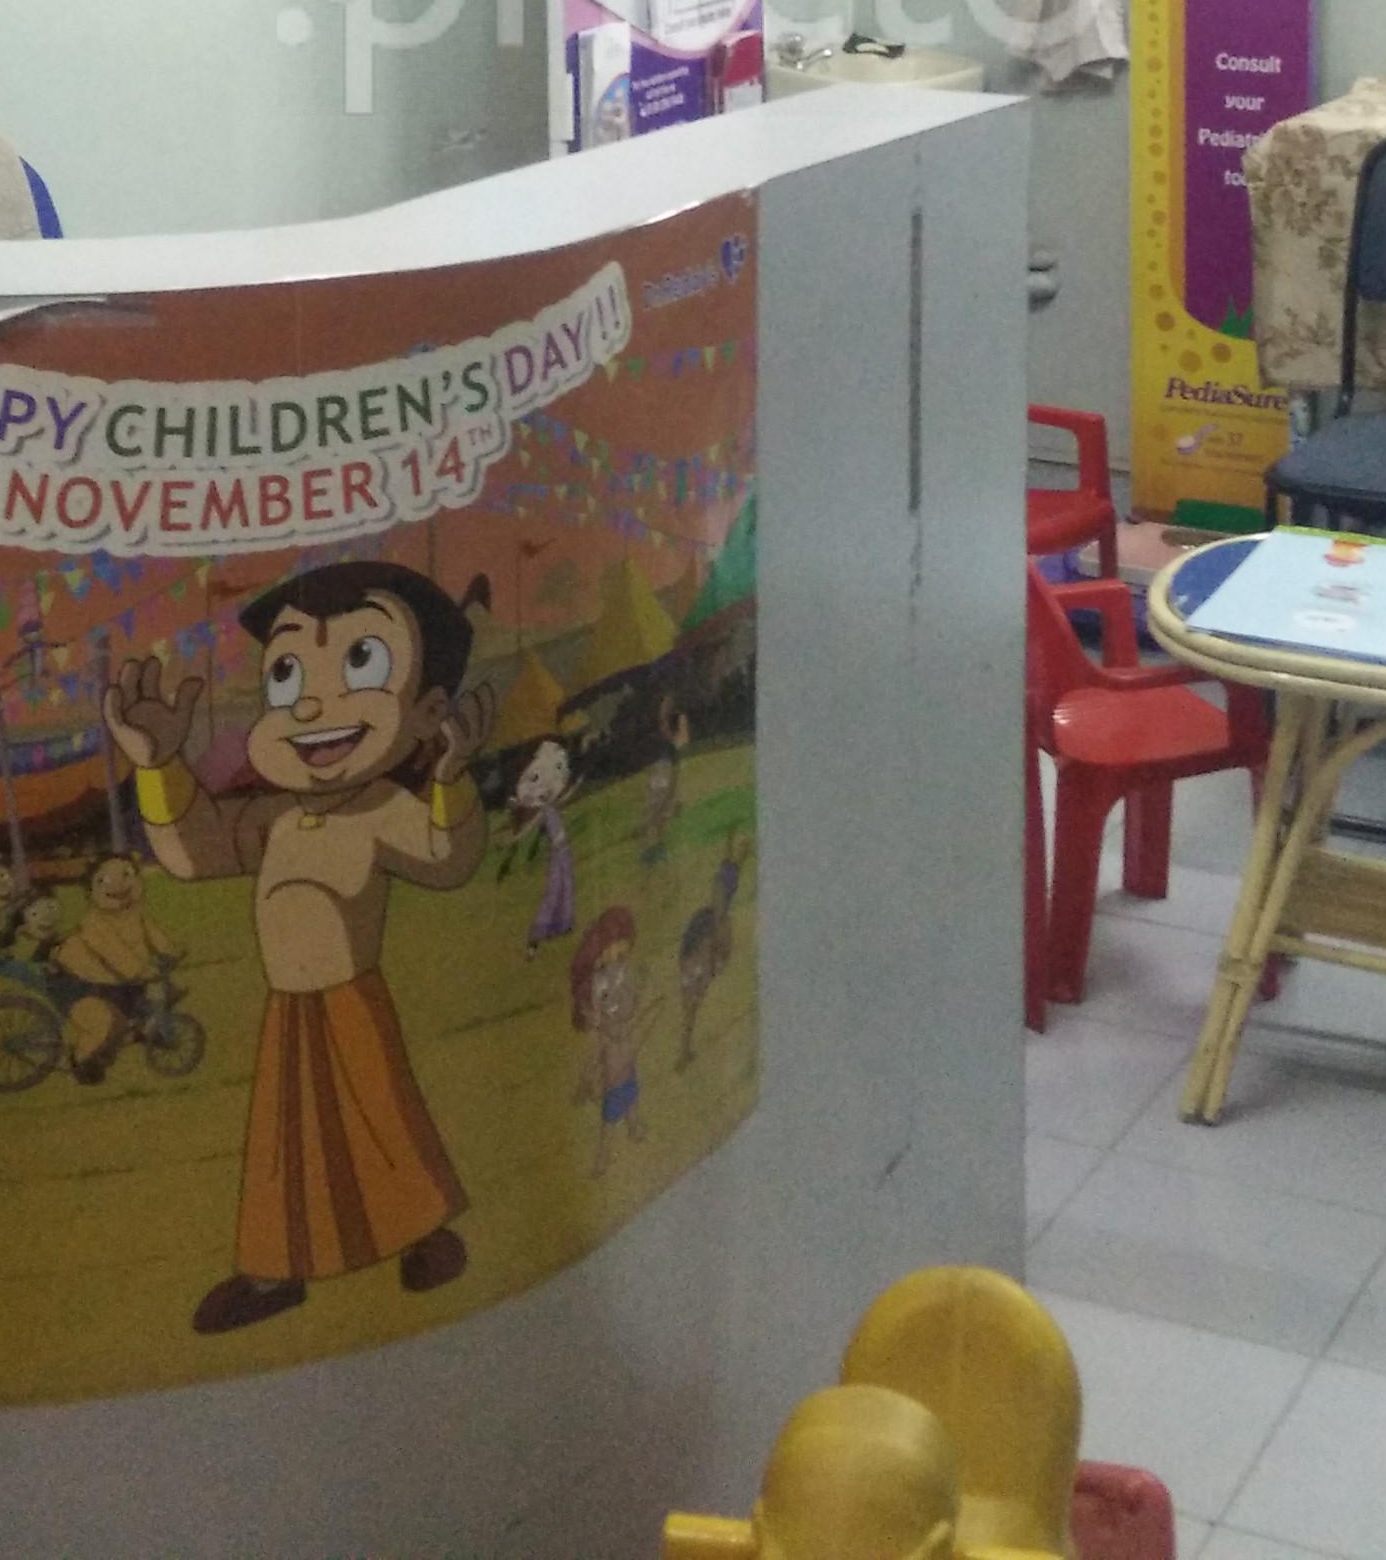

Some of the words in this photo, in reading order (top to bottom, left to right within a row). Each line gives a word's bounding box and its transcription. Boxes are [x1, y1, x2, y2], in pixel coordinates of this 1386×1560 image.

[1215, 52, 1282, 74] Consult
[1224, 95, 1265, 111] your
[104, 360, 490, 458] CHILDREN'S
[1165, 376, 1289, 410] PediaSure
[4, 460, 379, 533] NOVEMBER
